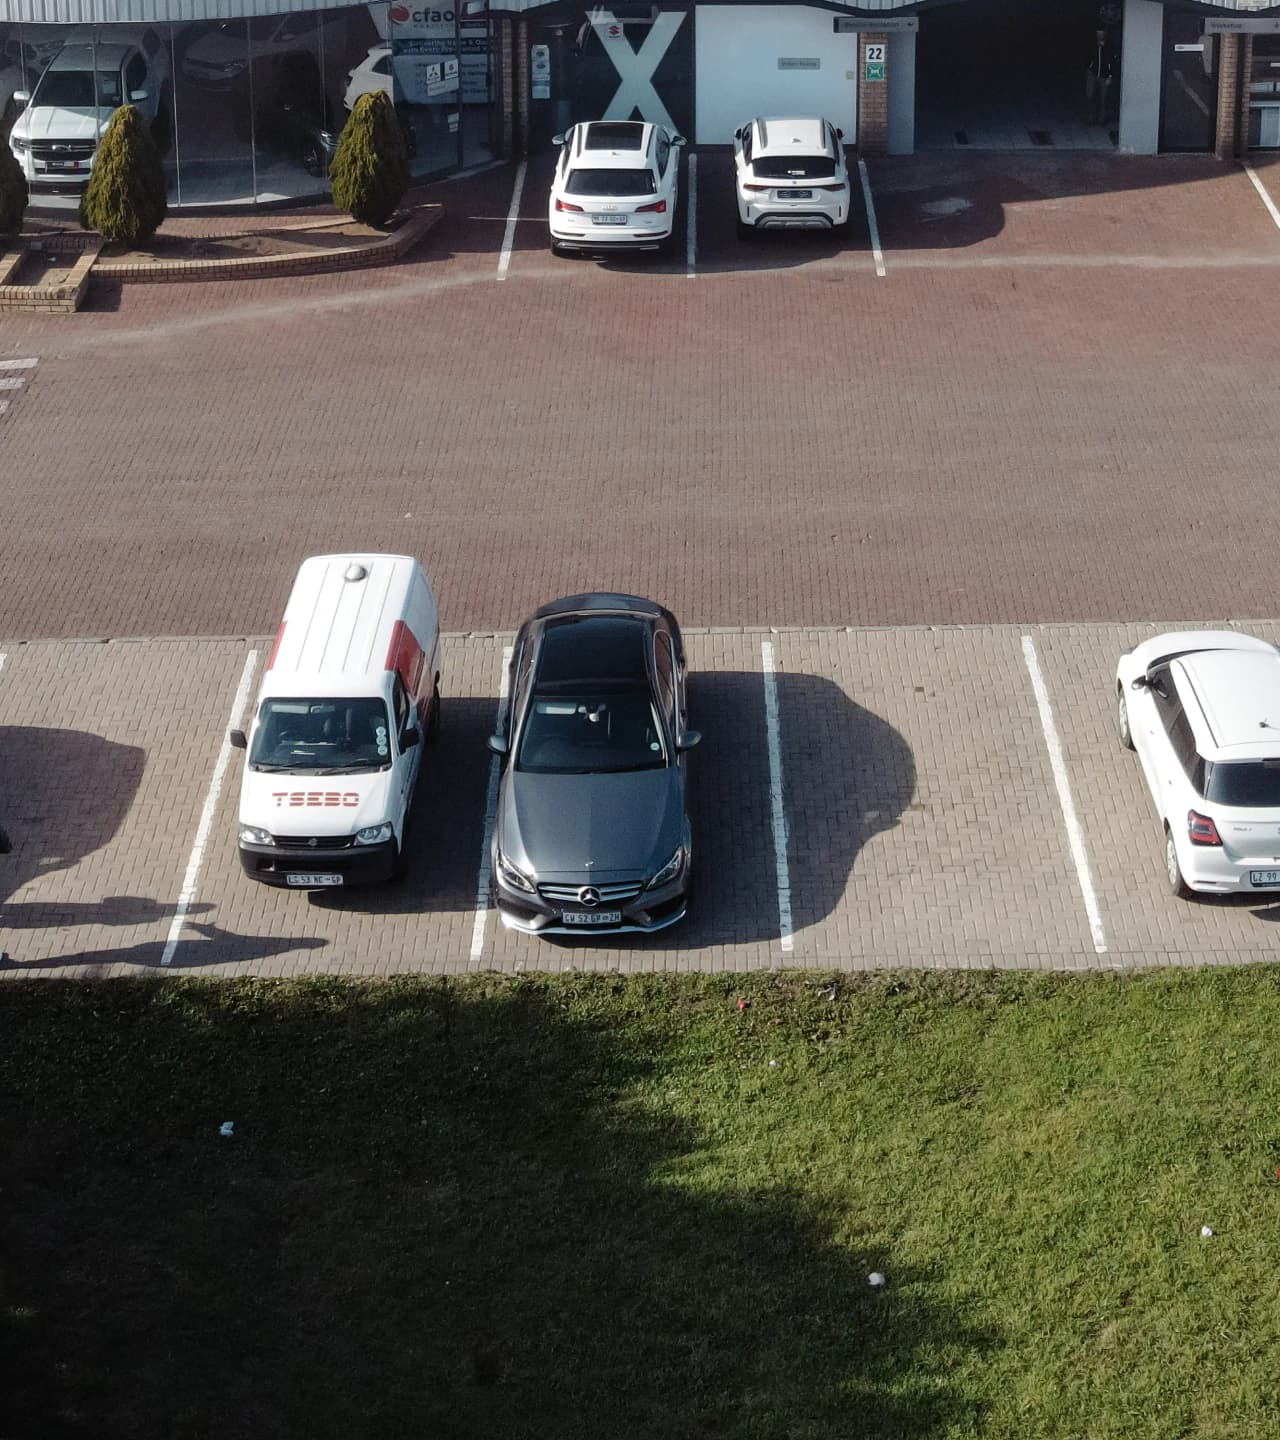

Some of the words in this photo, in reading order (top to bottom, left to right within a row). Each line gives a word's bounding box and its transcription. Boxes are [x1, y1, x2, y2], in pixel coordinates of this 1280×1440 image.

[412, 7, 455, 22] cfao
[868, 47, 883, 60] 22
[272, 792, 360, 807] TSEBO
